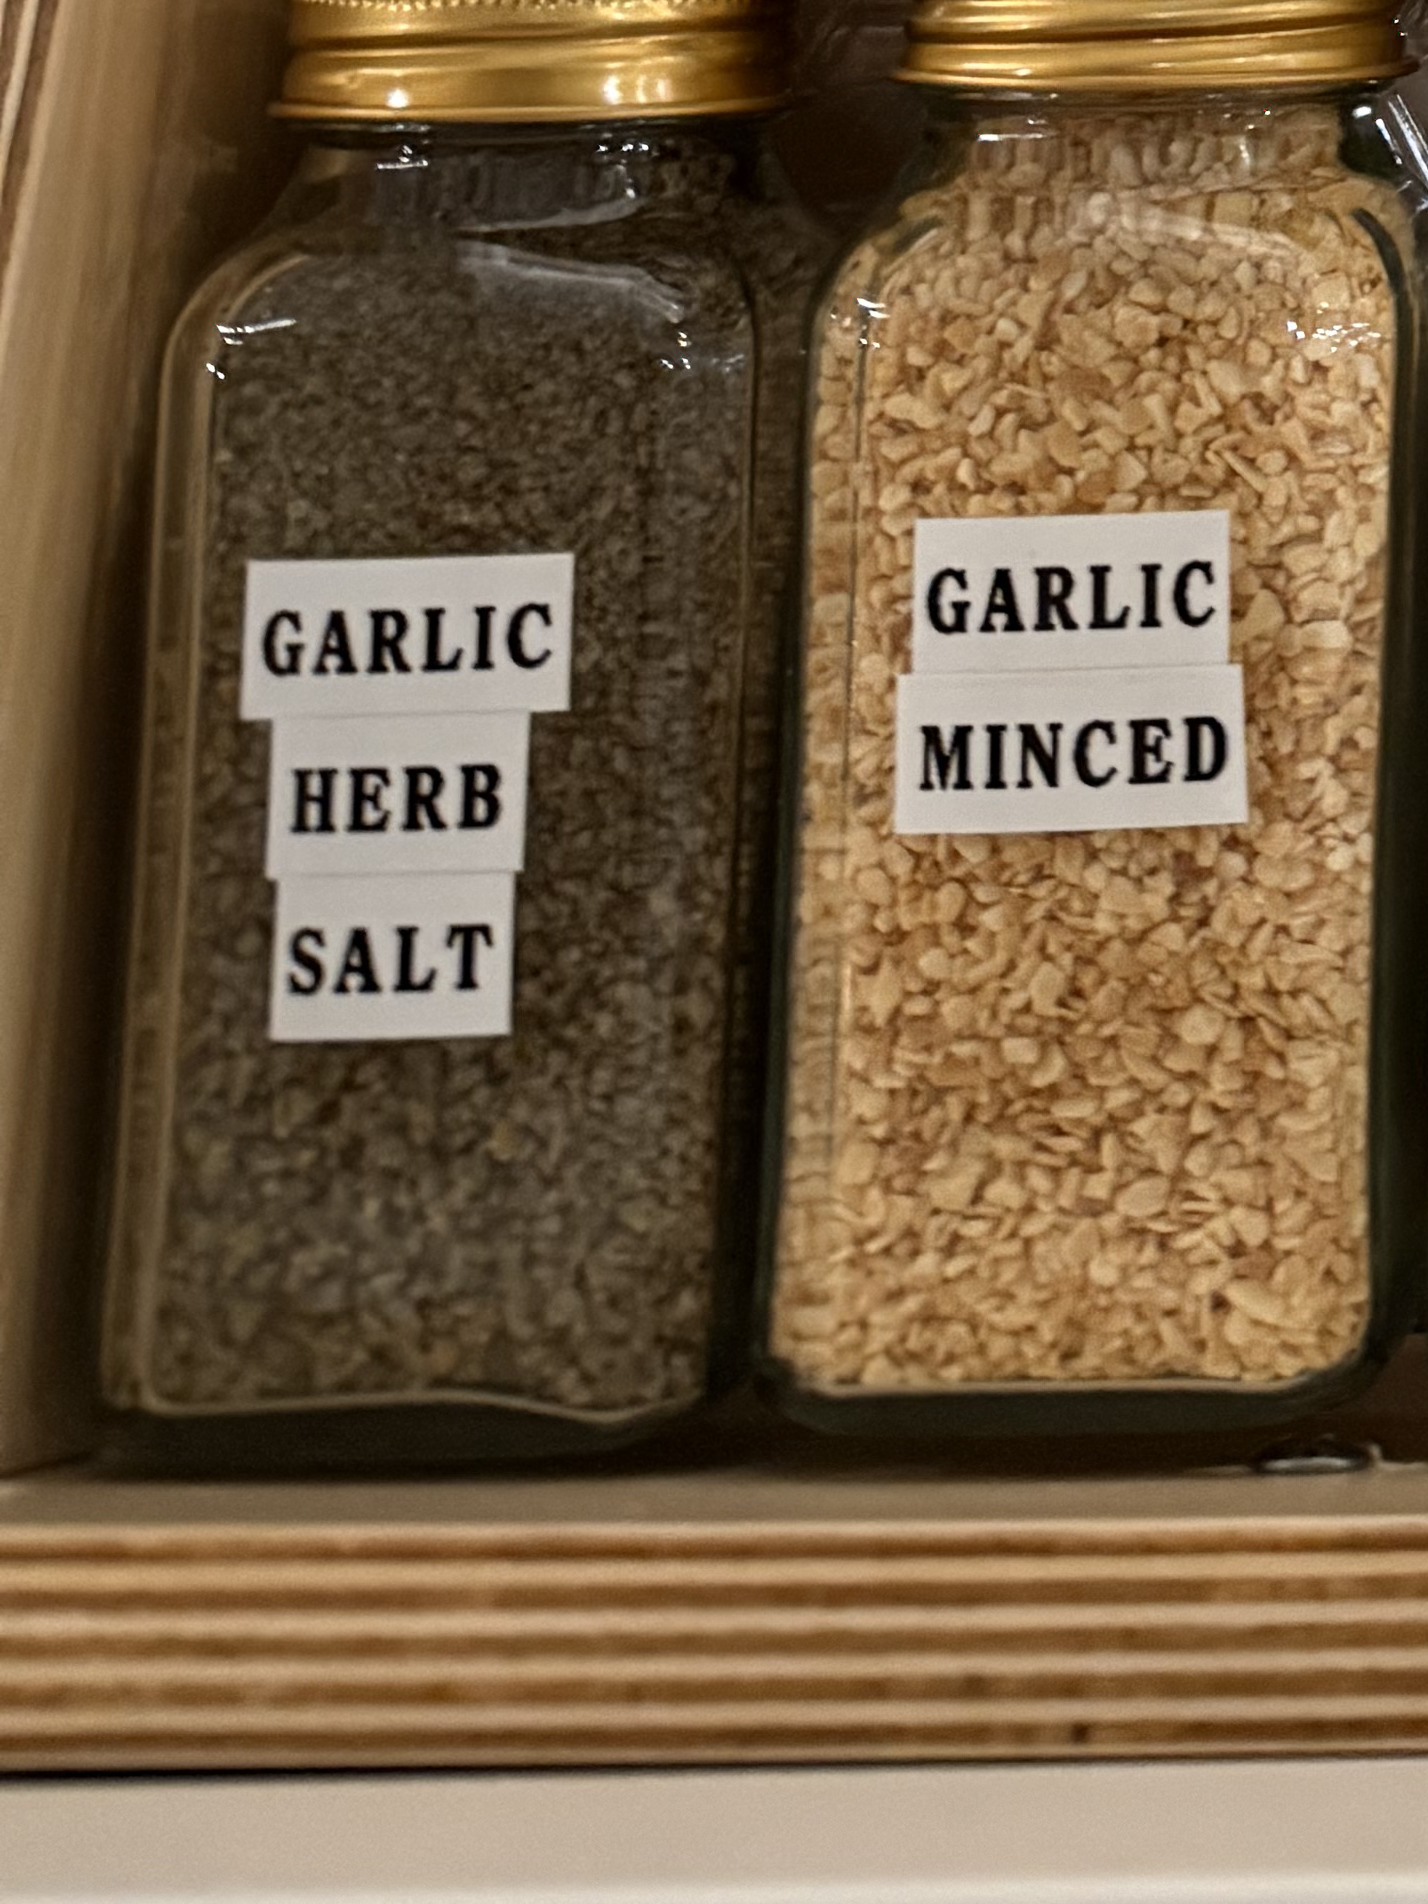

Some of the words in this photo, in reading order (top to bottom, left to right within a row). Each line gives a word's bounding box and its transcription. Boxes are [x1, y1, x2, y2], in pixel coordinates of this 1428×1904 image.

[925, 560, 1216, 635] GARLIC
[261, 603, 552, 678] GARLIC
[919, 716, 1228, 791] MINCED
[290, 764, 502, 835] HERB
[287, 923, 493, 997] SALT
